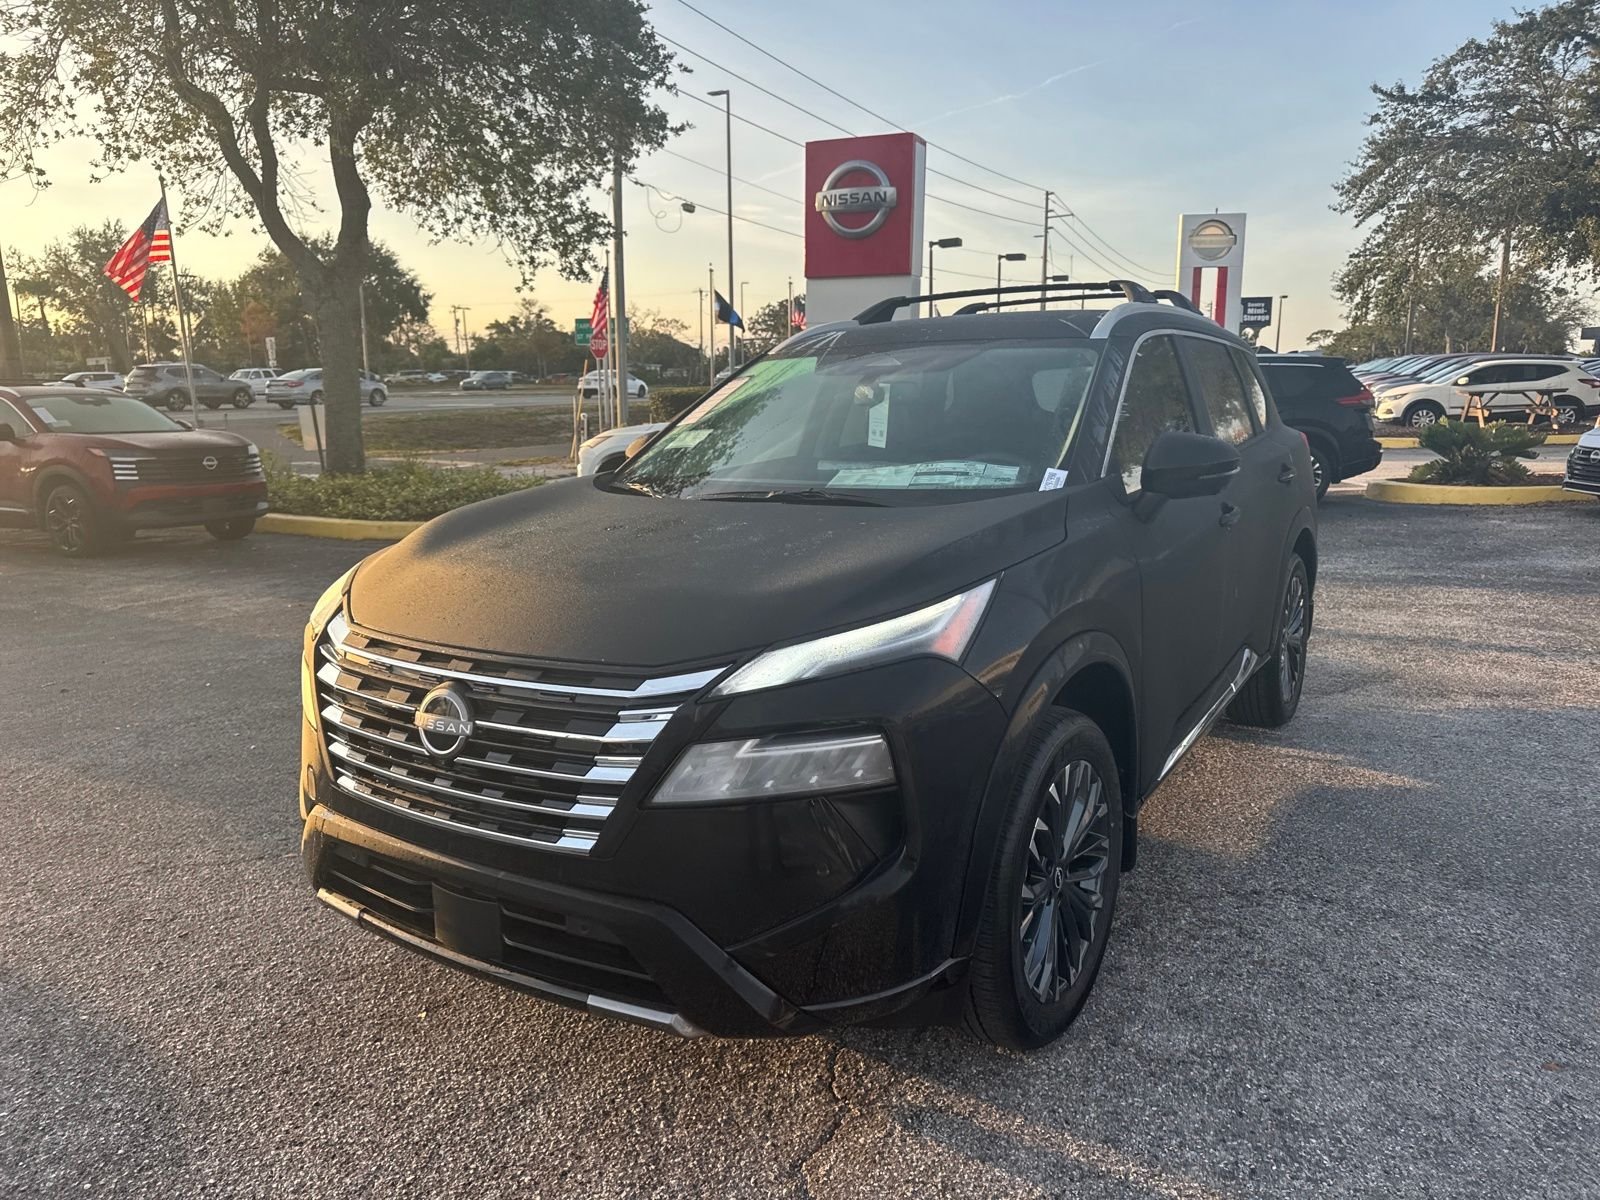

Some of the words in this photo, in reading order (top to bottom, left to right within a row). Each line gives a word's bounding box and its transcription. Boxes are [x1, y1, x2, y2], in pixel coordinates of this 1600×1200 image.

[821, 191, 887, 206] NISSAN
[591, 339, 608, 350] STOP
[417, 713, 471, 734] SSAN
